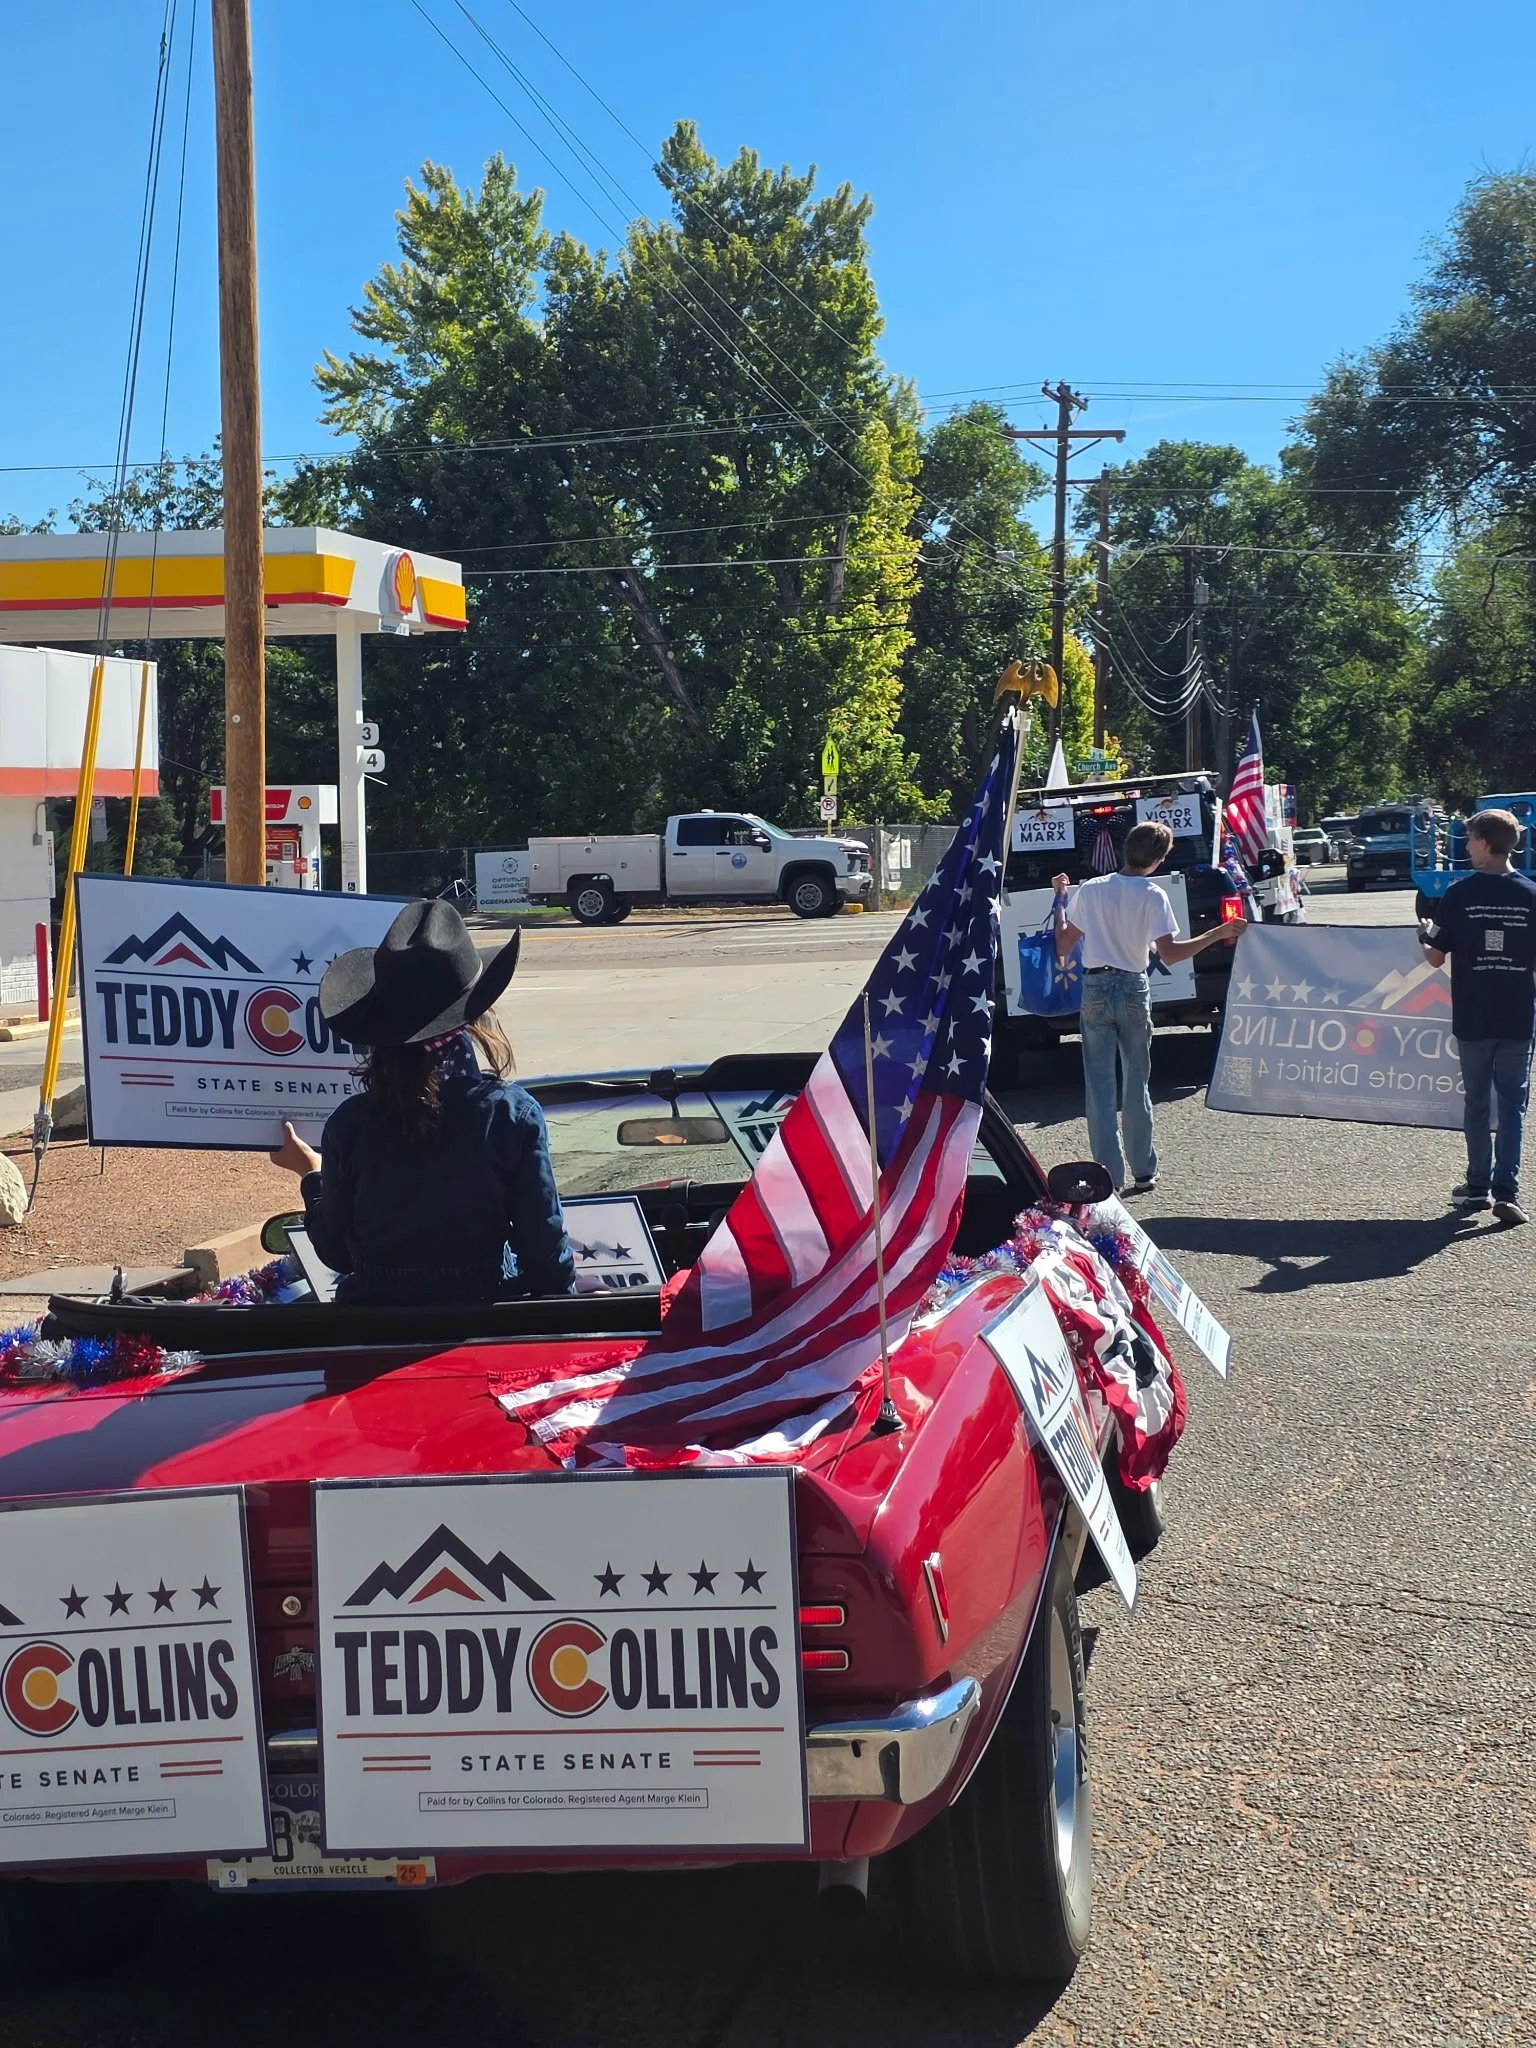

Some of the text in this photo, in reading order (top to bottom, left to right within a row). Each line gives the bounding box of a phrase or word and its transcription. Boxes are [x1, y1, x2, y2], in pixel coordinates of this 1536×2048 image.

[361, 726, 372, 741] 3
[366, 753, 378, 767] 4
[1077, 762, 1117, 771] Church Ave
[1145, 808, 1192, 821] VICTOR
[1019, 821, 1065, 832] VICTOR
[1156, 817, 1193, 829] ARX
[1020, 830, 1066, 843] MARX
[96, 981, 239, 1050] TEDDY
[198, 1077, 353, 1096] STATE SENATE
[172, 1105, 188, 1113] Paid
[200, 1106, 208, 1115] by
[210, 1106, 232, 1115] Collins
[335, 1617, 781, 1720] TEDDY COLLINS
[1, 1638, 239, 1738] COLLINS
[461, 1752, 672, 1772] STATE SENATE
[39, 1766, 139, 1787] SENATE
[427, 1797, 446, 1806] Paid
[448, 1797, 461, 1806] for
[463, 1797, 474, 1807] by
[476, 1796, 506, 1805] Collins
[508, 1796, 520, 1805] for
[568, 1794, 616, 1805] Registered
[618, 1794, 645, 1804] Agent
[647, 1793, 676, 1804] Marge
[678, 1793, 701, 1803] Klein
[45, 1809, 89, 1820] Registered
[91, 1807, 117, 1818] Agent
[119, 1805, 146, 1817] Marge
[147, 1804, 169, 1814] Klein
[228, 1870, 237, 1883] 9
[273, 1865, 368, 1875] COLLECTOR VEHICLE
[400, 1865, 417, 1881] 25
